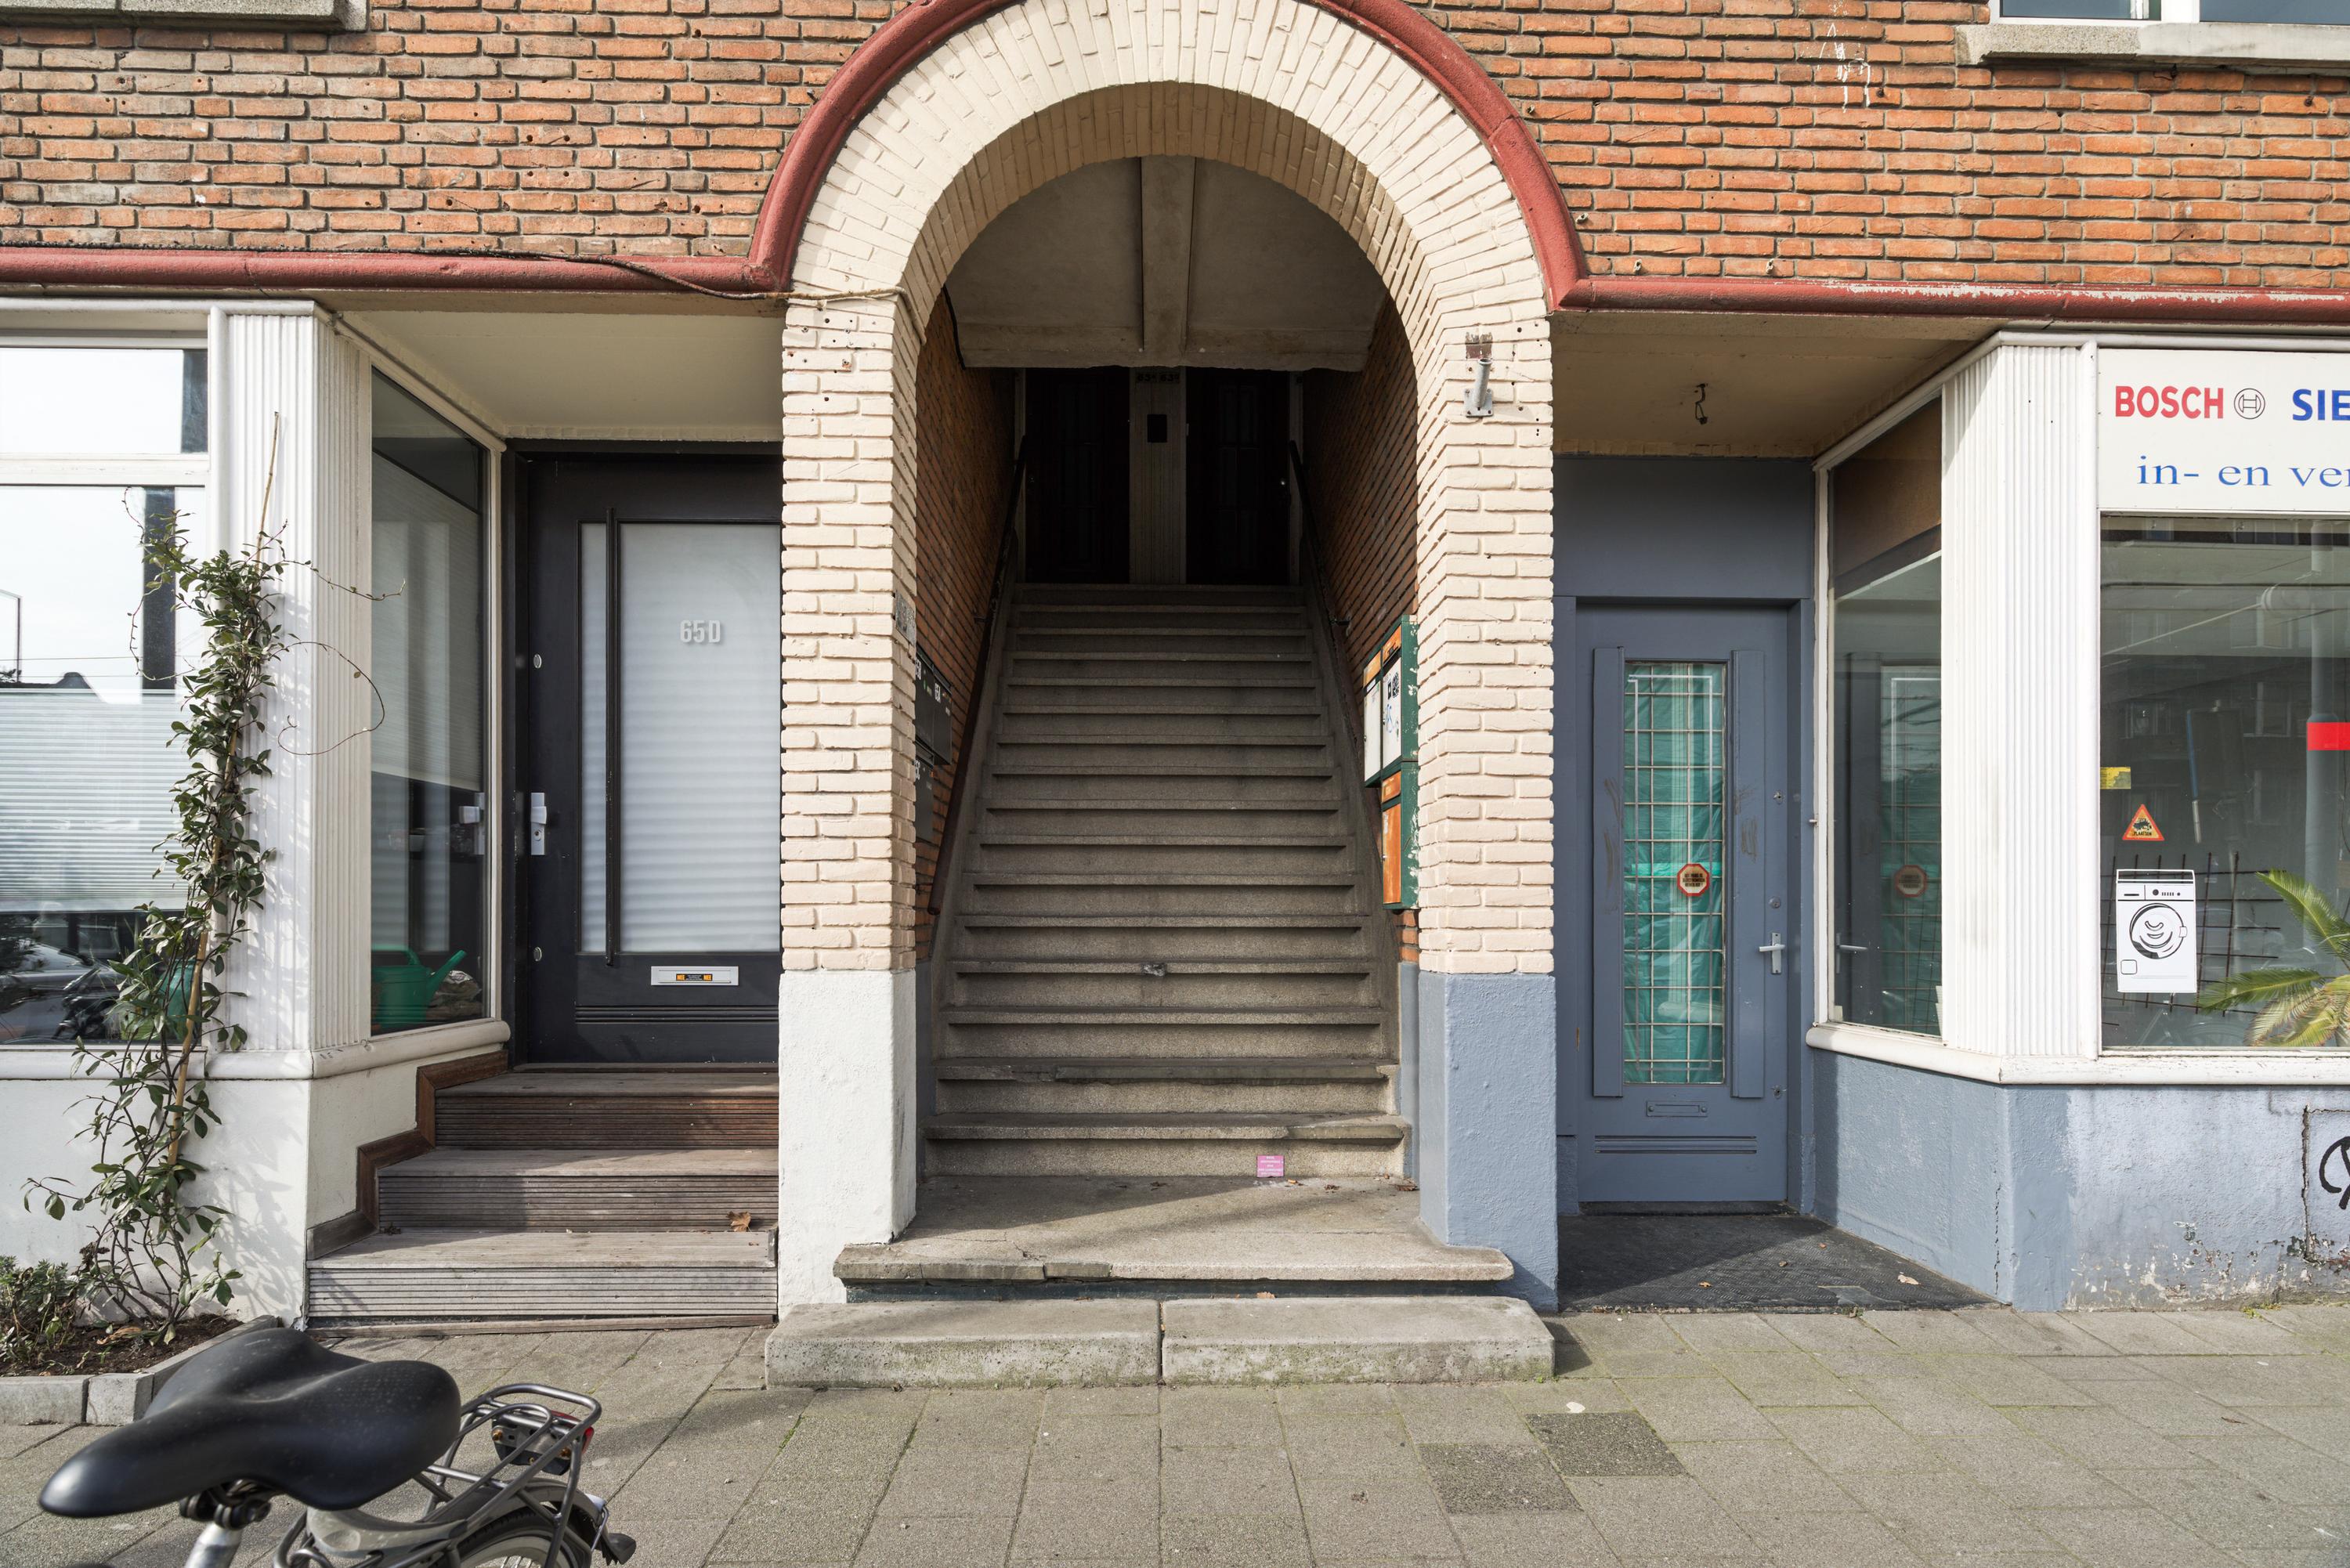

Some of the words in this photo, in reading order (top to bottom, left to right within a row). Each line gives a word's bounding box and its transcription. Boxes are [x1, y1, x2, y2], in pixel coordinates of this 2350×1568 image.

[2115, 385, 2224, 419] BOSCH
[2292, 388, 2350, 421] SIE
[2137, 455, 2199, 485] in-
[2218, 465, 2272, 486] en
[2289, 465, 2350, 487] ve
